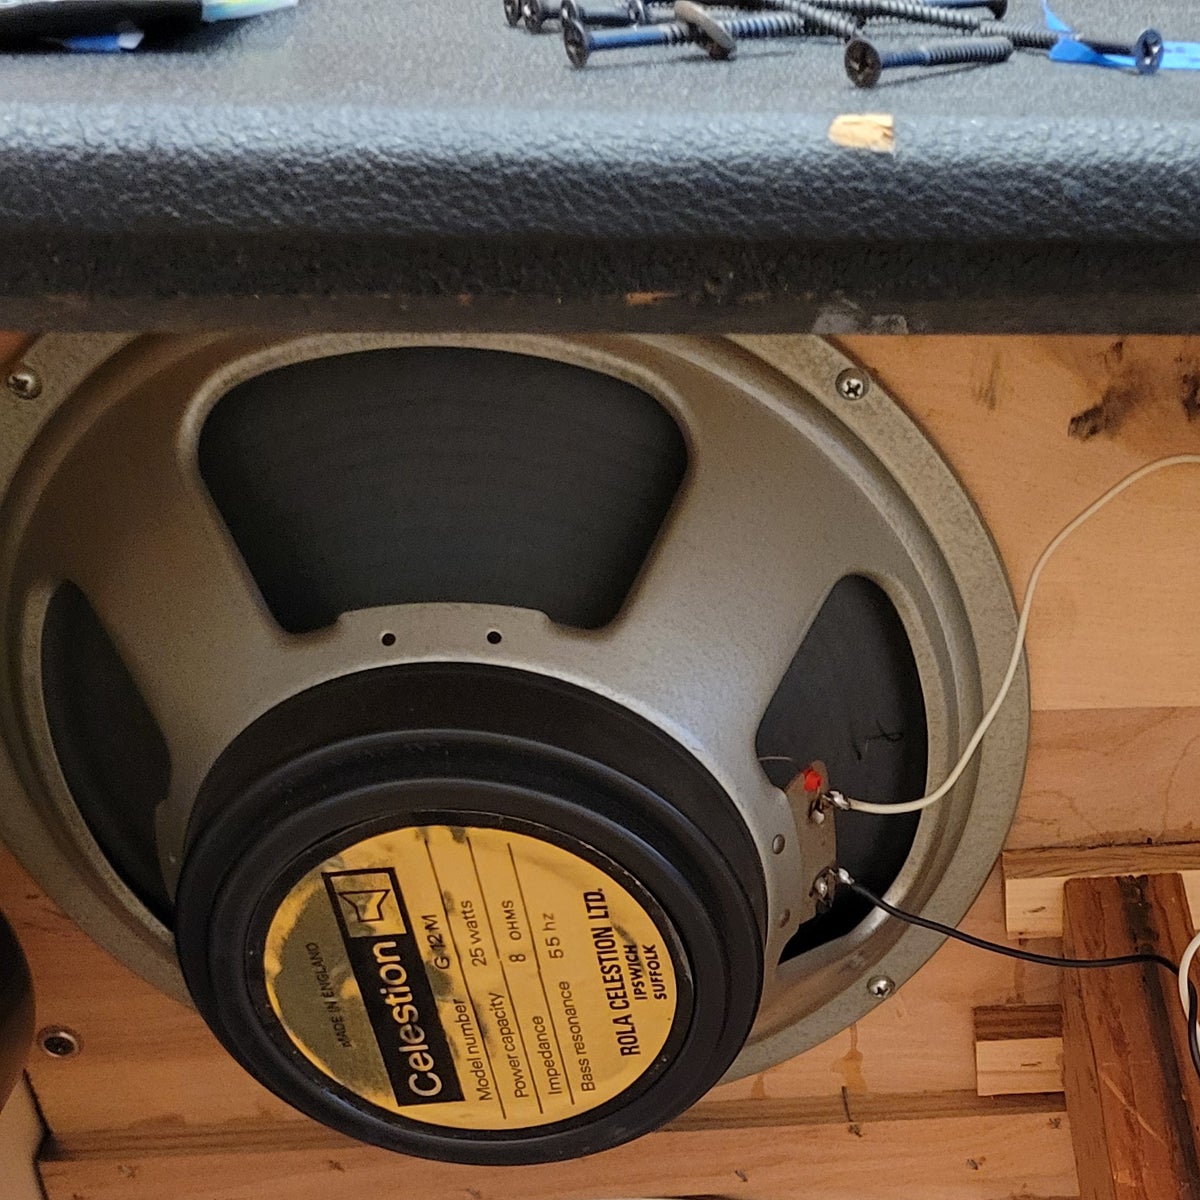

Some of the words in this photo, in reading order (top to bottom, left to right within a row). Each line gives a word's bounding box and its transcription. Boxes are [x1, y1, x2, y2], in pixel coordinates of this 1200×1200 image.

[456, 900, 483, 944] watts
[500, 900, 522, 940] OHMS
[539, 913, 557, 931] hz
[581, 888, 609, 920] LTD.
[304, 943, 335, 997] ENGLAND
[469, 948, 488, 966] 25
[509, 954, 527, 963] 8
[545, 937, 564, 959] 55
[591, 927, 632, 1011] CELESTION
[621, 944, 650, 1001] IPSWICH
[641, 944, 668, 1000] SUFFOLK
[323, 1000, 340, 1014] IN
[366, 942, 445, 1098] Celestion
[449, 998, 480, 1054] number
[485, 992, 520, 1052] capacity
[555, 981, 589, 1055] resonance
[528, 1016, 566, 1095] Impedance
[613, 1015, 642, 1057] ROLA
[467, 1058, 495, 1101] Model
[504, 1054, 530, 1098] Power
[576, 1059, 597, 1091] Bass
